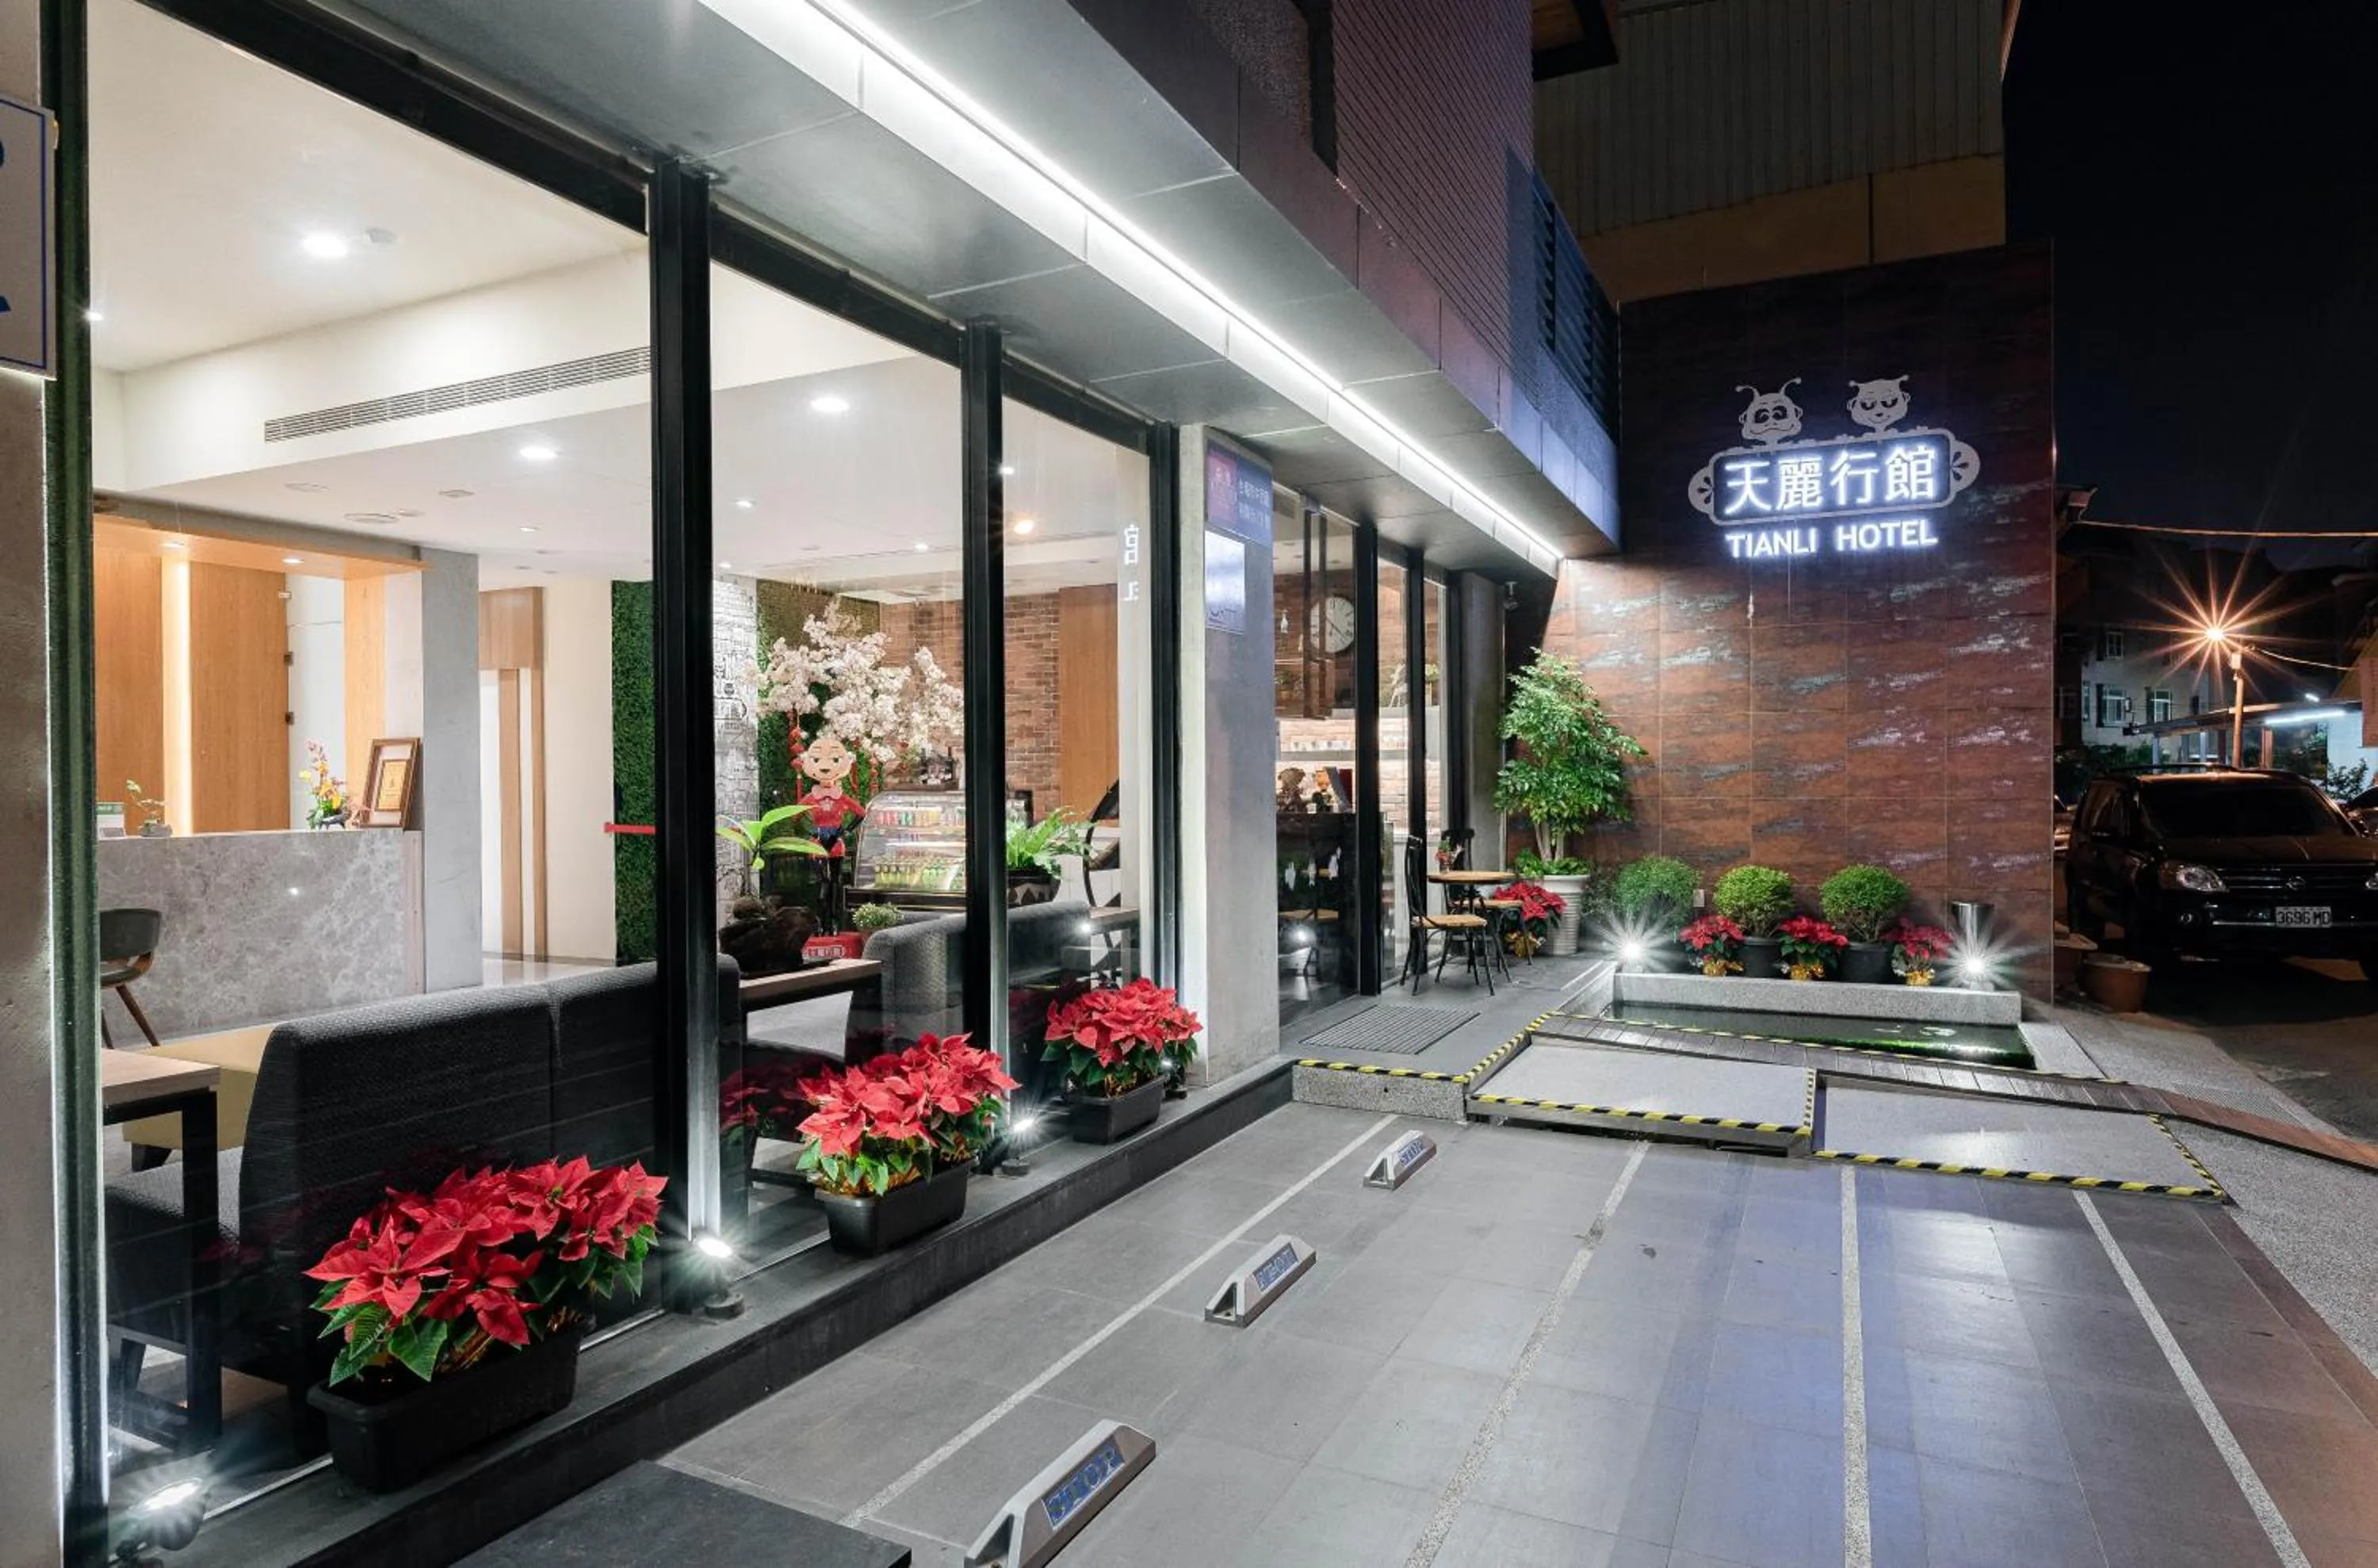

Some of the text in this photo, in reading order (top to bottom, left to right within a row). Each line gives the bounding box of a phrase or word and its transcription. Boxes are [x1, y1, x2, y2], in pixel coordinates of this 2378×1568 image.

[1724, 446, 1936, 514] 天麗行館
[1724, 519, 1939, 558] TIANLI HOTEL
